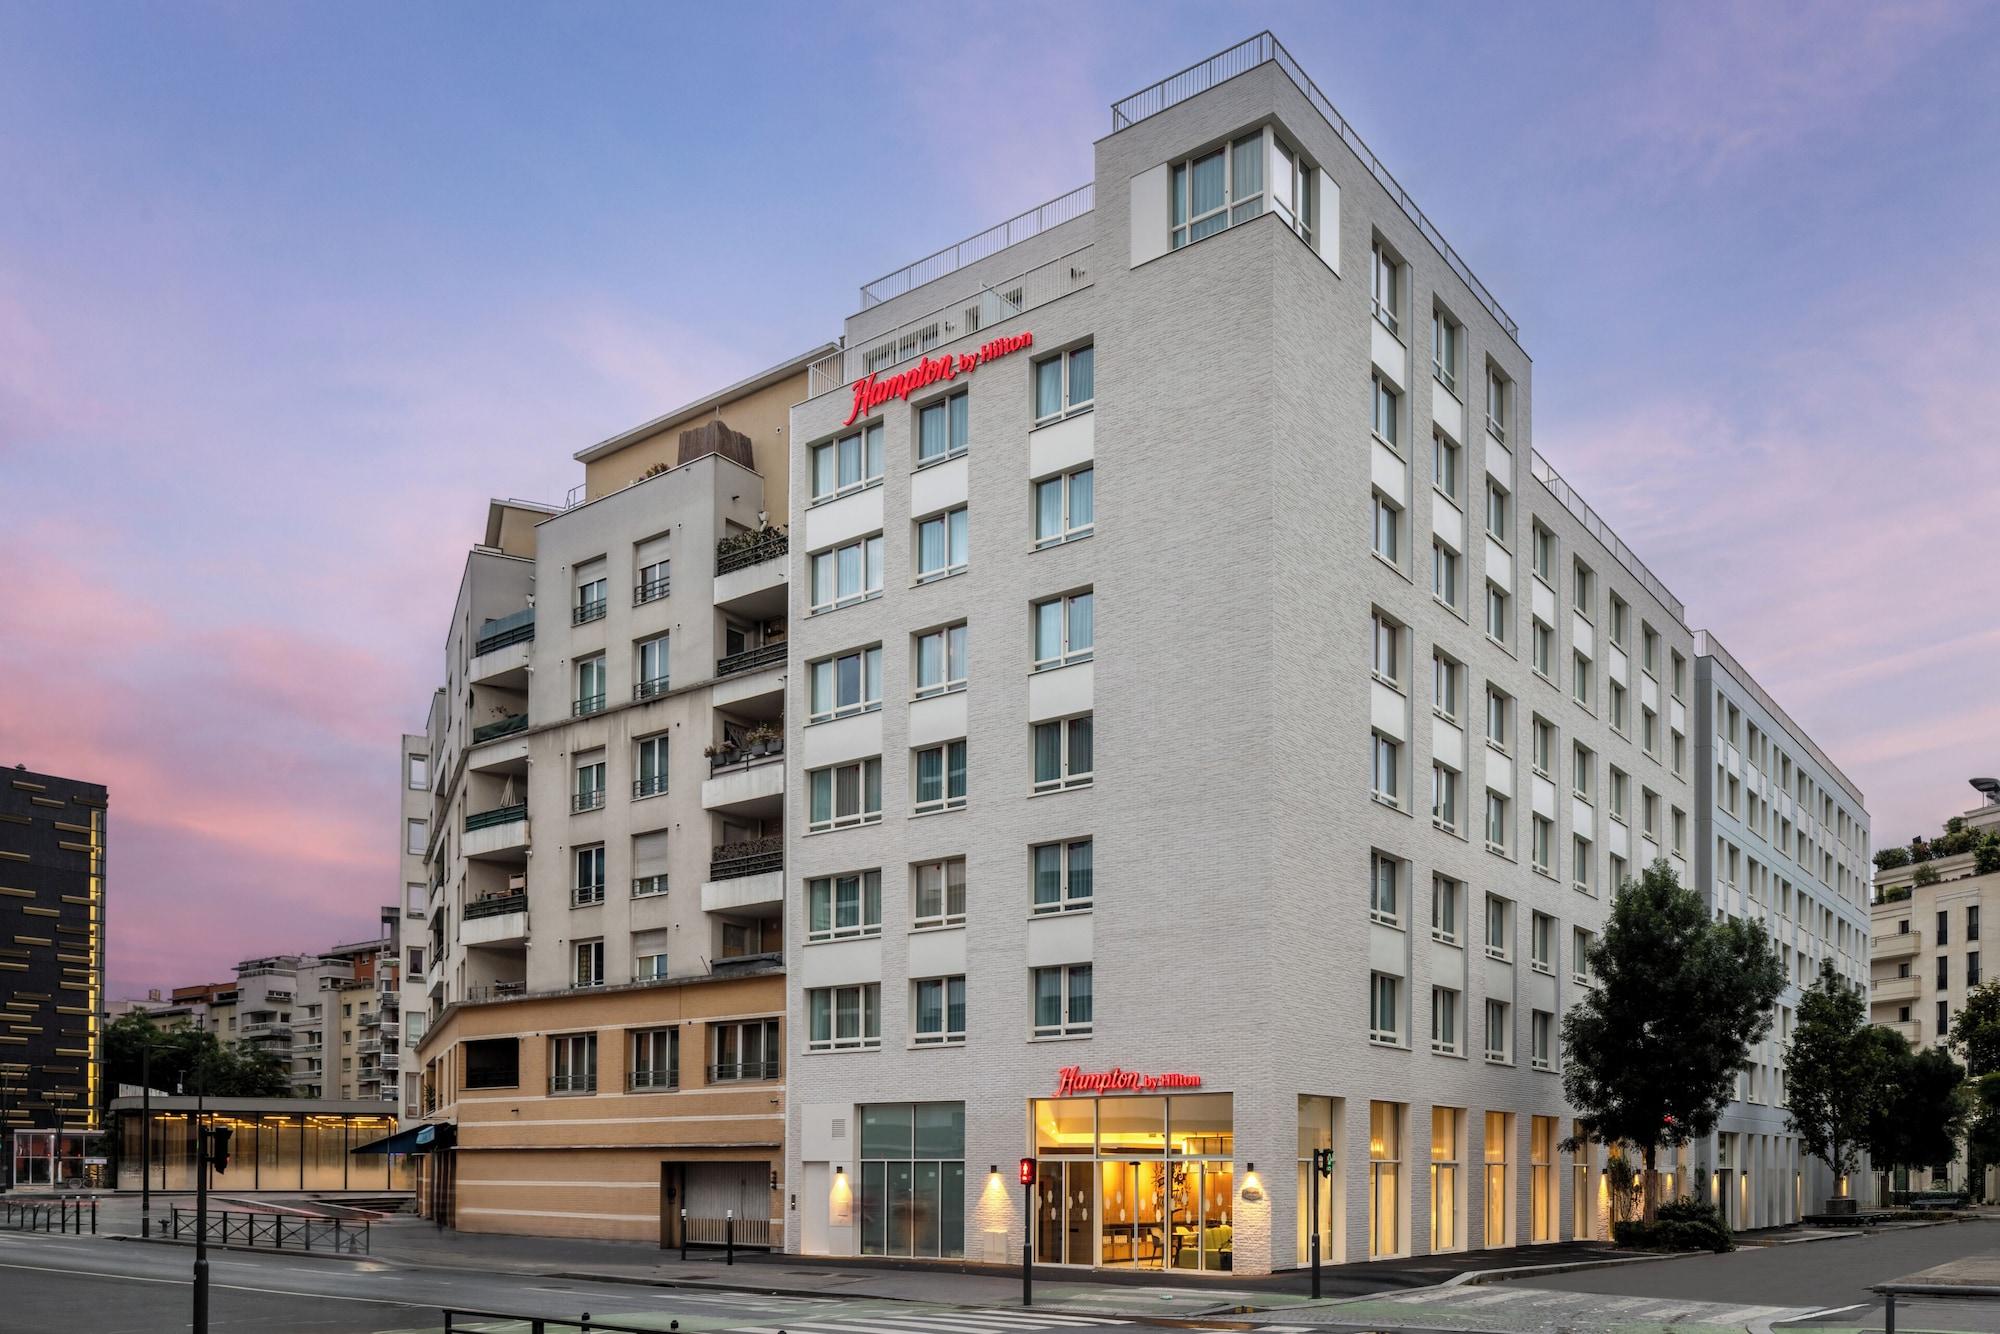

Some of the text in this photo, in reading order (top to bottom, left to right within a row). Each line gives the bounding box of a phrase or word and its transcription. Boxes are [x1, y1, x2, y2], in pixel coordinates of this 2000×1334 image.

[843, 332, 1033, 426] Hampton by Hilton
[1052, 1066, 1201, 1098] Hampton by Hilton
